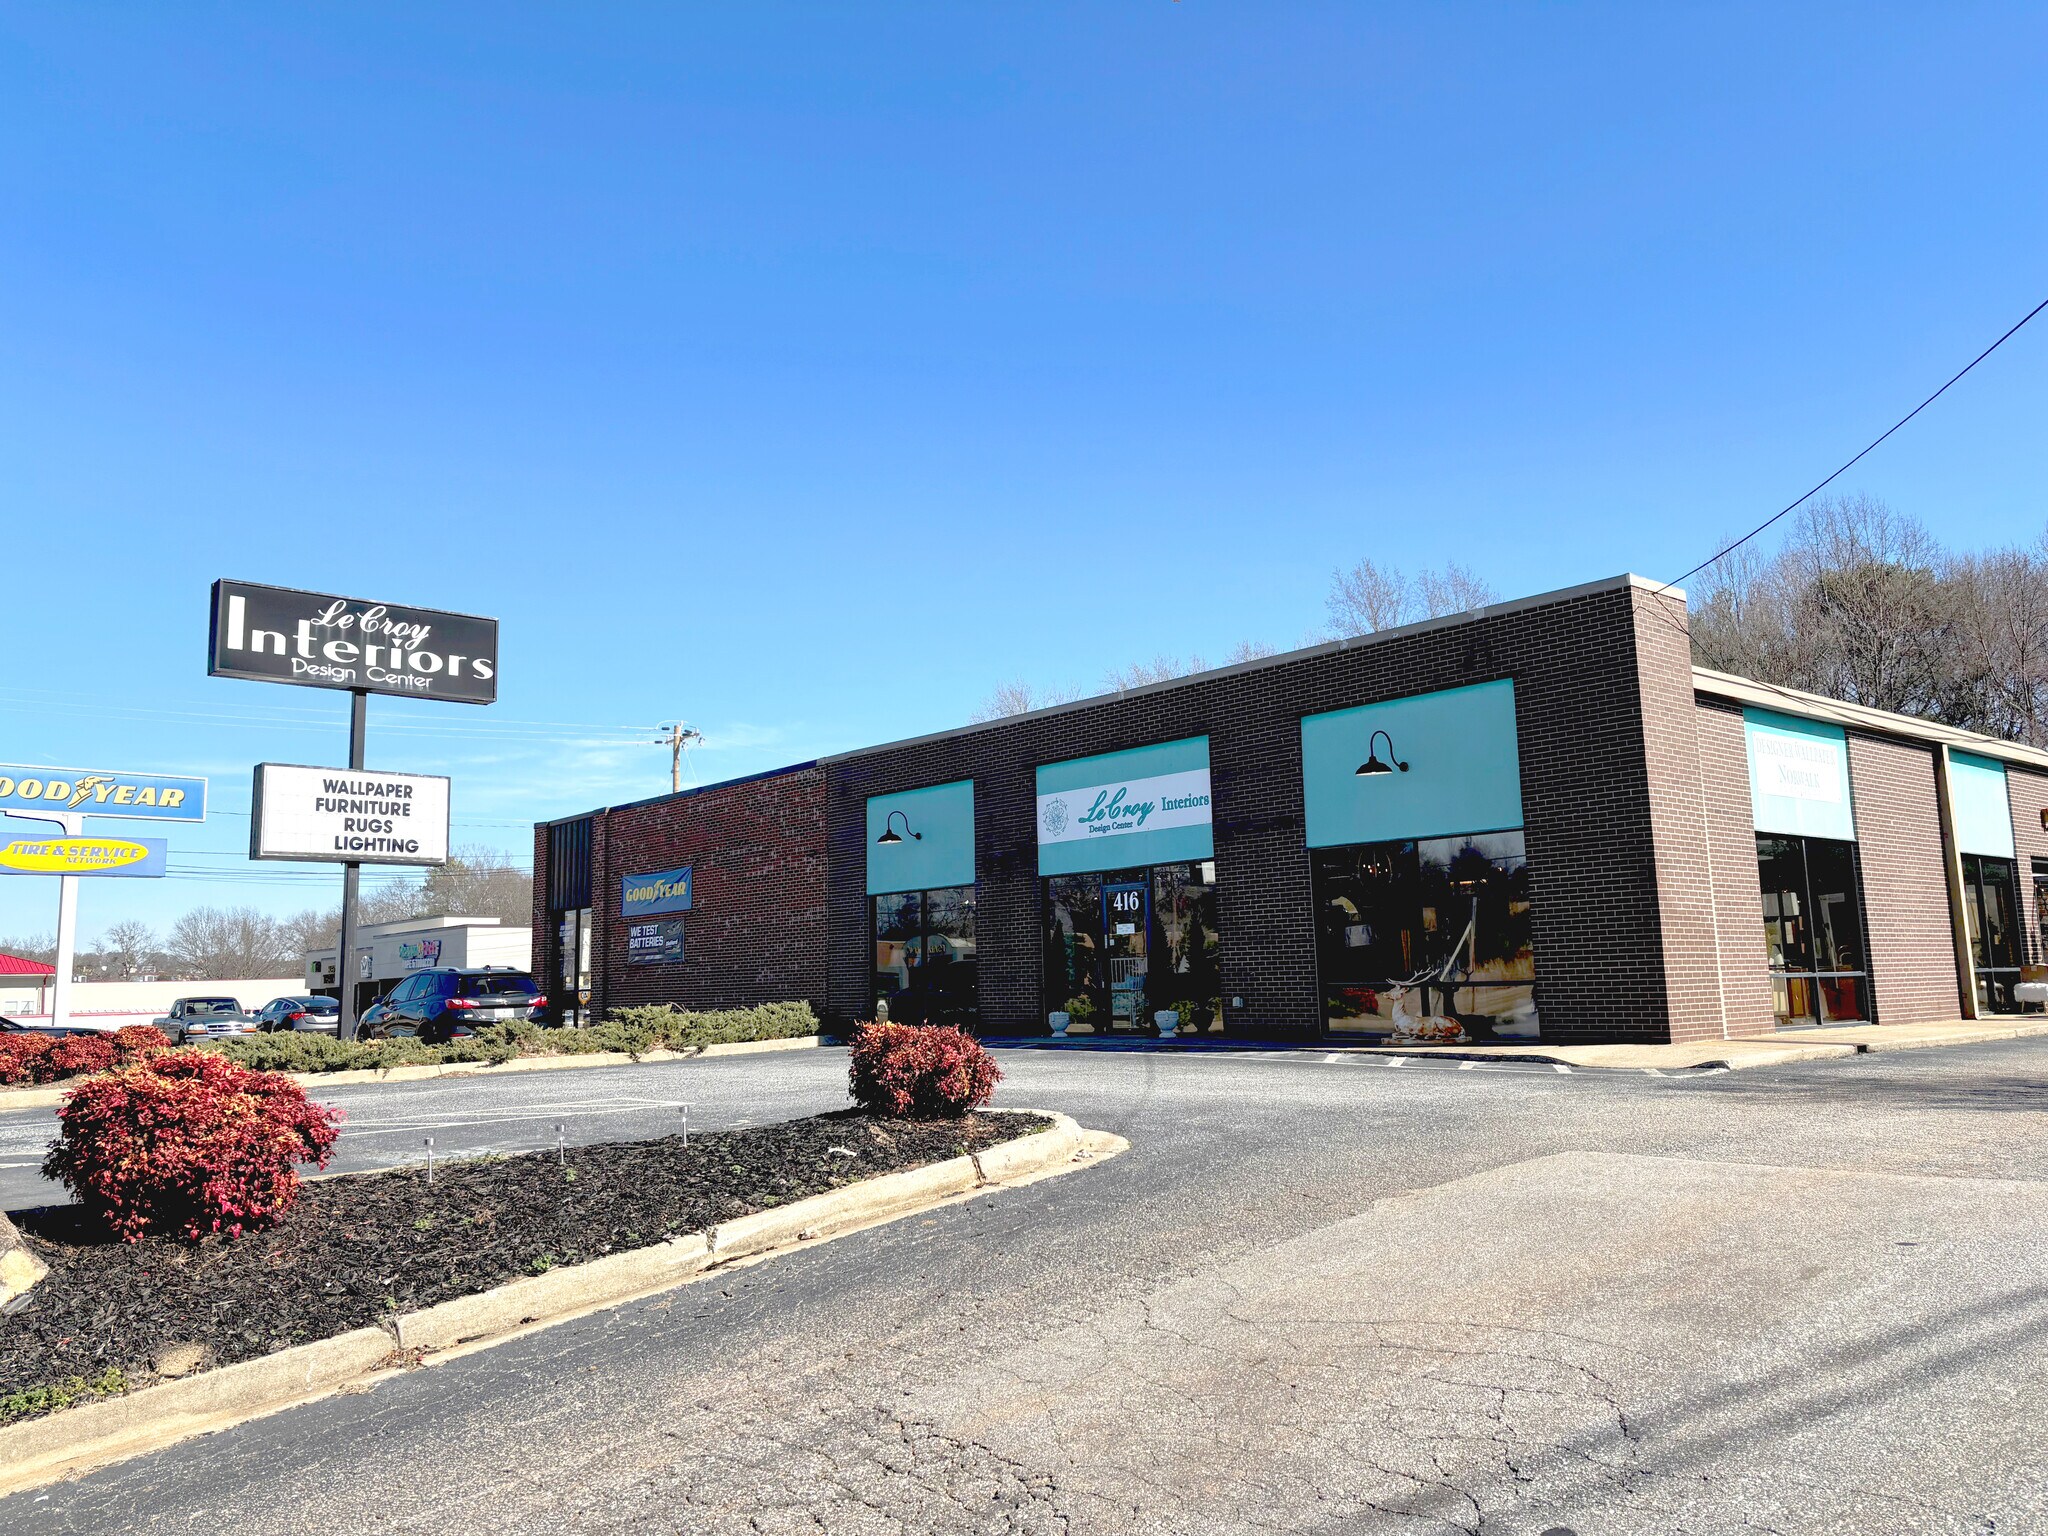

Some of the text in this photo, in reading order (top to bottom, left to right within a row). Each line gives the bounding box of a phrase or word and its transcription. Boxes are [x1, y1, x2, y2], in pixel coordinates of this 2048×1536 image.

[227, 595, 494, 680] Interiors
[291, 657, 433, 688] Design Center
[1756, 738, 1794, 758] DESIGNER
[0, 776, 185, 809] OODYEAR
[323, 779, 413, 799] WALLPAPER
[315, 797, 411, 817] FURNITURE
[1161, 793, 1210, 811] Interiors
[344, 817, 393, 834] RUGS
[1089, 821, 1133, 834] Design Center
[12, 843, 140, 859] TIRE & SERVICE
[334, 835, 419, 854] LIGHTING
[65, 857, 117, 865] NETWORK
[1113, 891, 1139, 911] 416
[631, 924, 658, 937] WE TEST
[629, 936, 664, 949] BATTERIES
